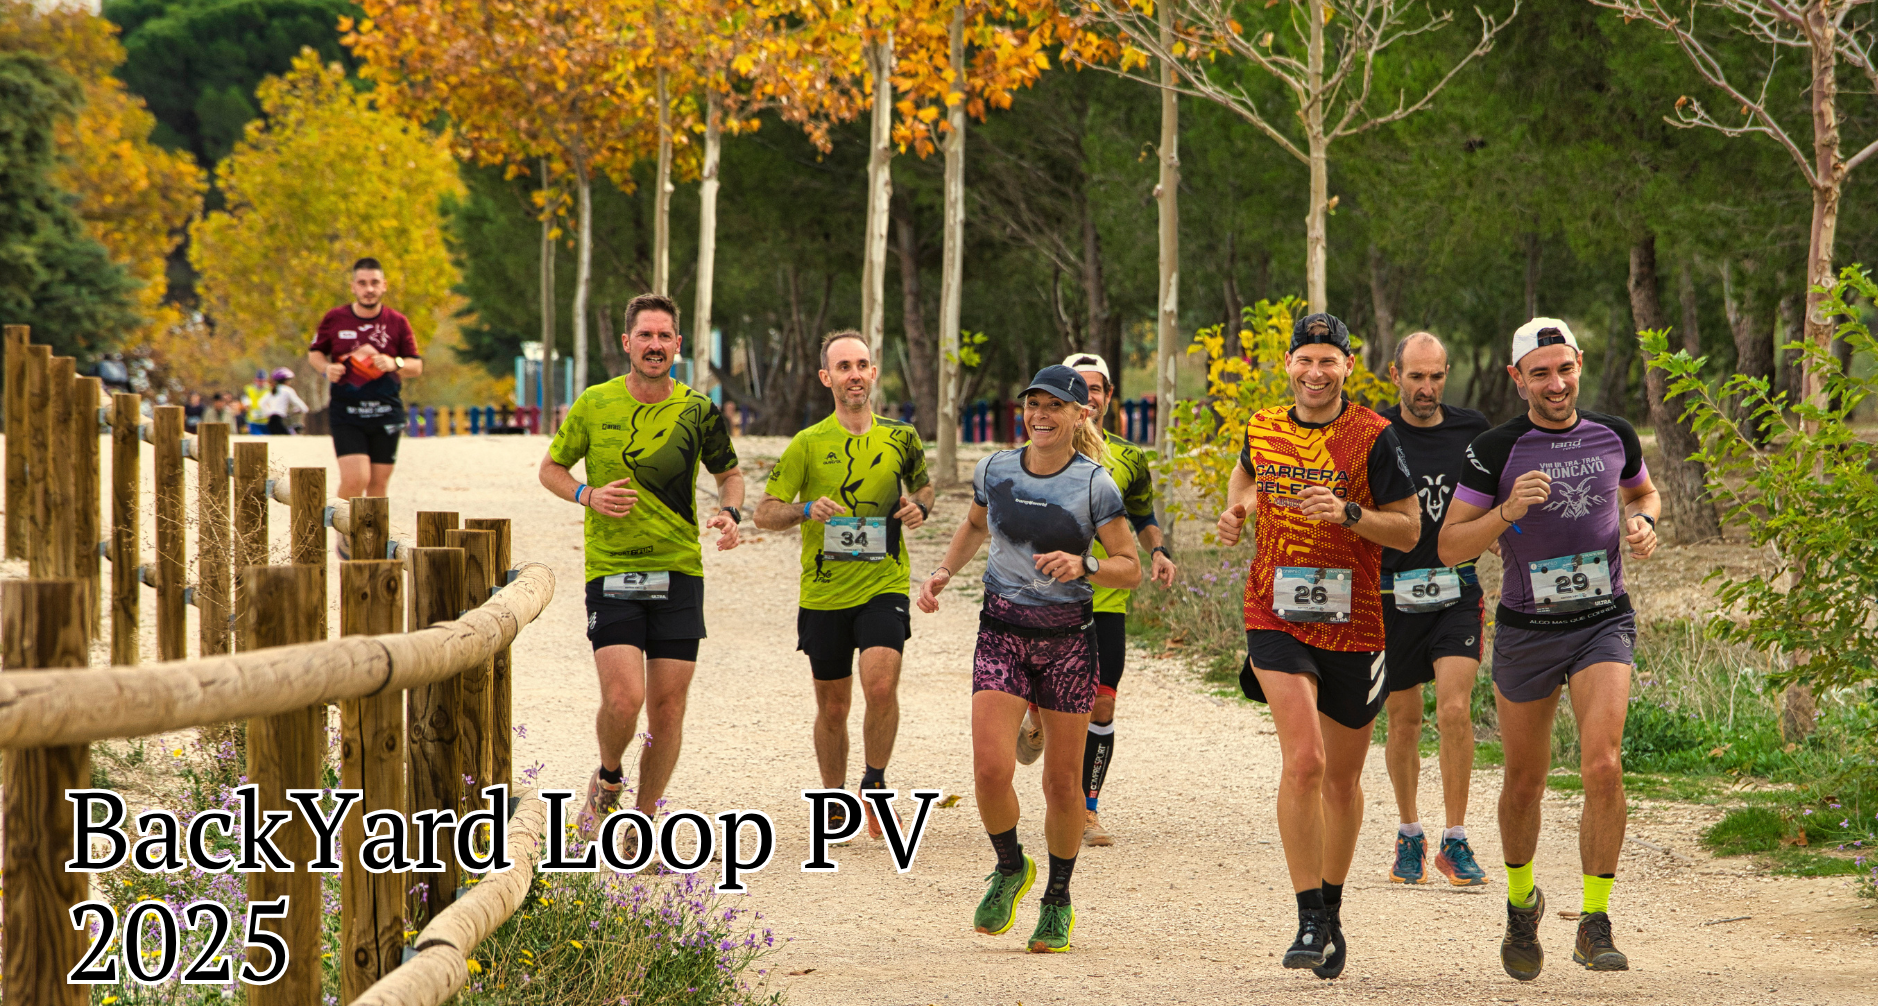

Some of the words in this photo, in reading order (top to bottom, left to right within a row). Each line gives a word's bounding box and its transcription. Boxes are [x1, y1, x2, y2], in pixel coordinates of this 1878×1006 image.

[1551, 438, 1582, 450] land
[1256, 464, 1350, 483] CARRERA
[1256, 481, 1287, 495] DEL
[841, 531, 869, 547] 34
[623, 571, 649, 585] 27
[1555, 572, 1589, 594] 29
[1294, 585, 1328, 605] 26
[1412, 583, 1440, 598] 50
